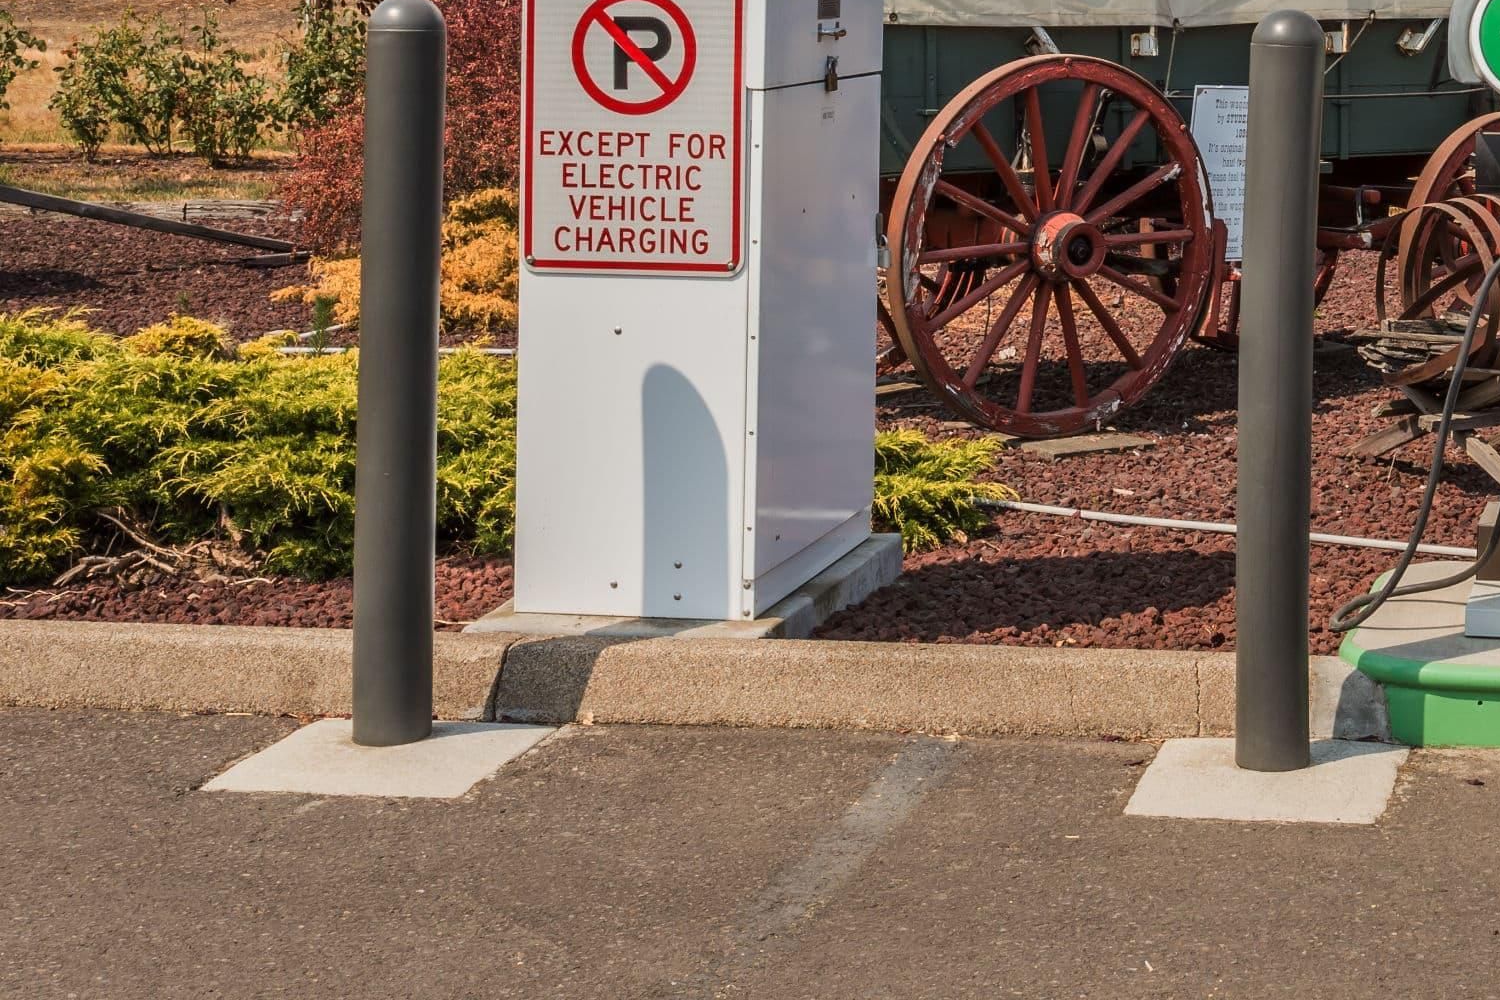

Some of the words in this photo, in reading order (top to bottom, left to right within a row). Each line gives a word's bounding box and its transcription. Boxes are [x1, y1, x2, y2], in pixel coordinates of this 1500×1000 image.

[539, 130, 650, 158] EXCEPT
[669, 133, 726, 160] FOR
[562, 162, 702, 191] ELECTRIC
[568, 194, 695, 223] VEHICLE
[554, 225, 709, 255] CHARGING
